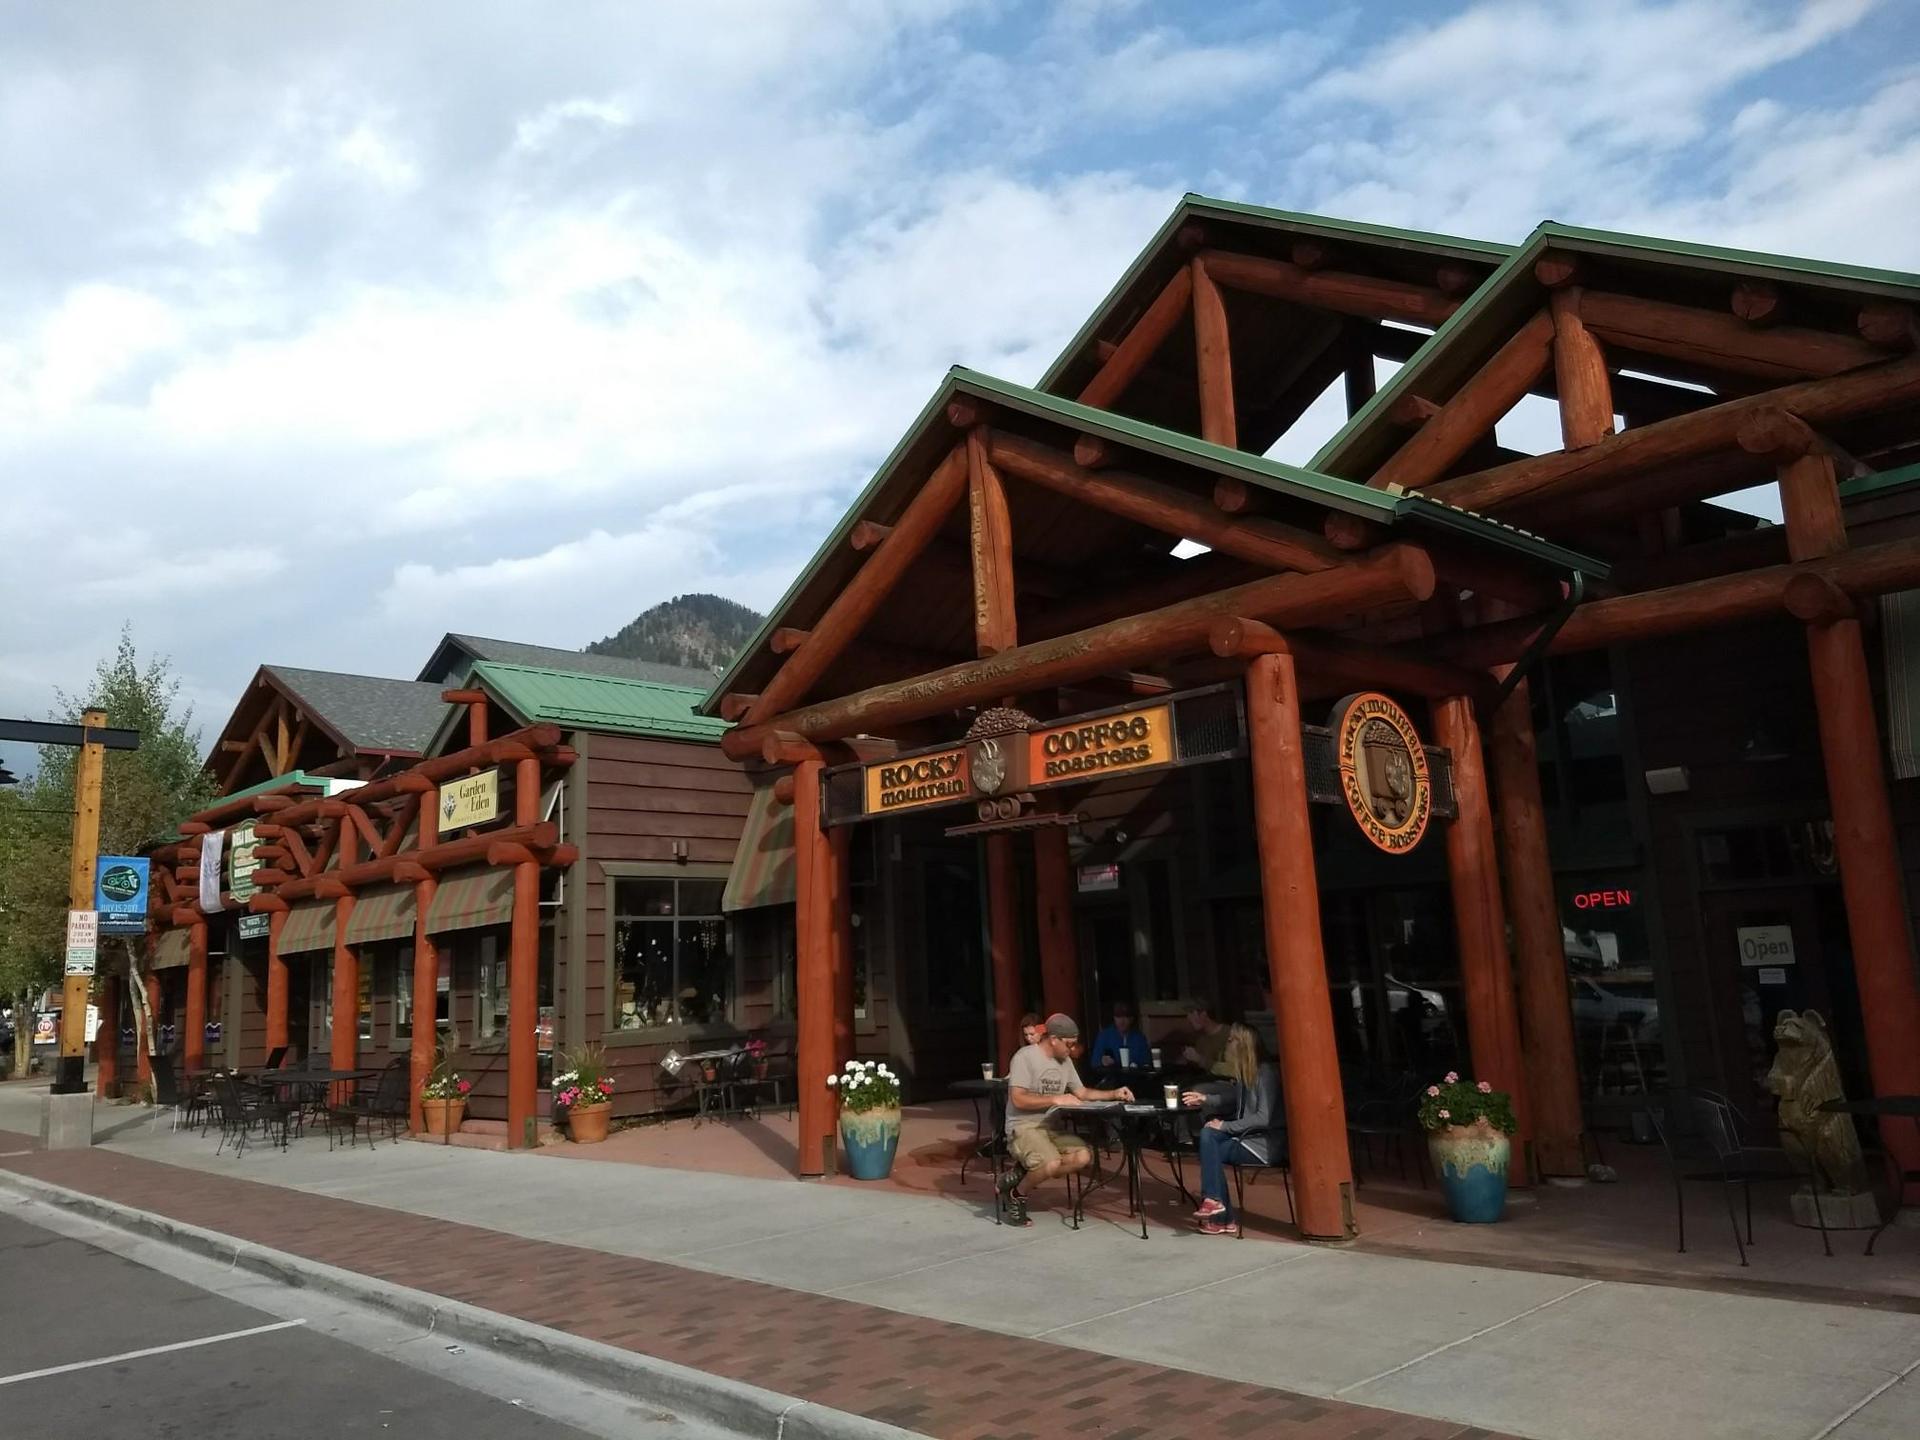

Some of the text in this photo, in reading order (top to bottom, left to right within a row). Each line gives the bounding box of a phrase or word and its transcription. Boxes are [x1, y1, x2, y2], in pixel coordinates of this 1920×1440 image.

[880, 753, 965, 790] ROCKY
[459, 780, 486, 799] Garden
[470, 795, 490, 812] Eden
[1574, 889, 1631, 909] OPEN
[1743, 938, 1790, 961] Open
